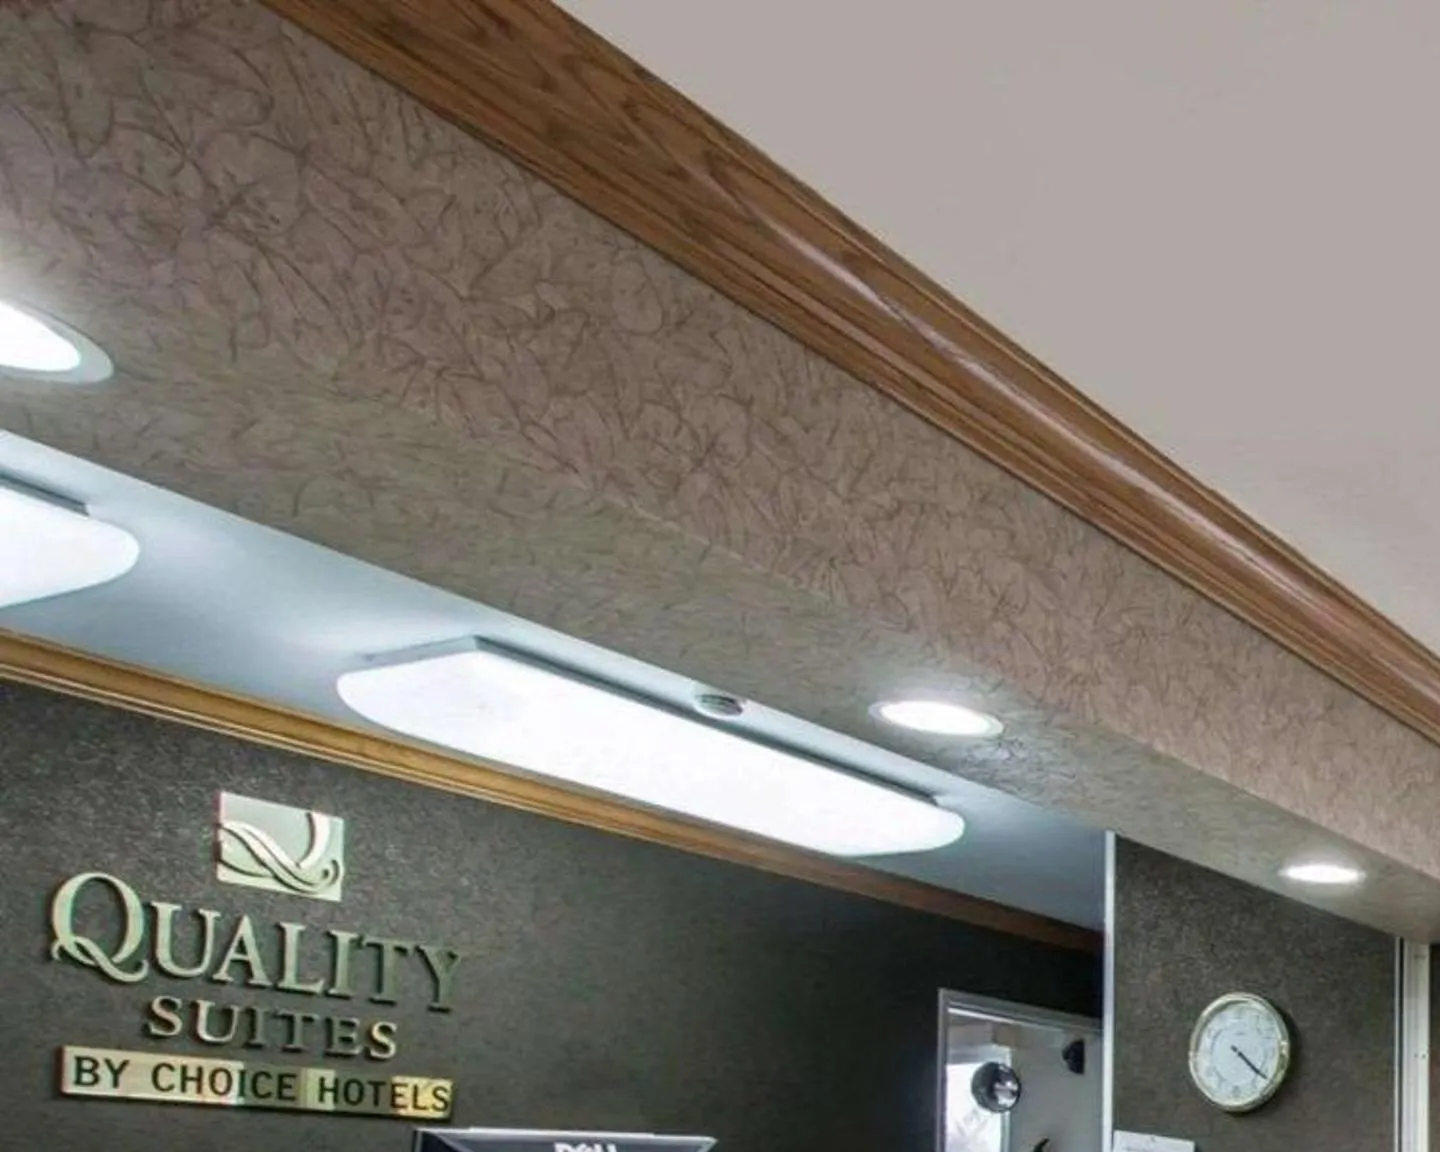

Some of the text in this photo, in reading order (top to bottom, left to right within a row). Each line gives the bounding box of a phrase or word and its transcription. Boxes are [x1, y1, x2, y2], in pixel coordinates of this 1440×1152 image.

[51, 871, 463, 1012] QUALITY
[144, 995, 398, 1060] SUITES
[73, 1056, 450, 1113] BY CHOICE HOTELS
